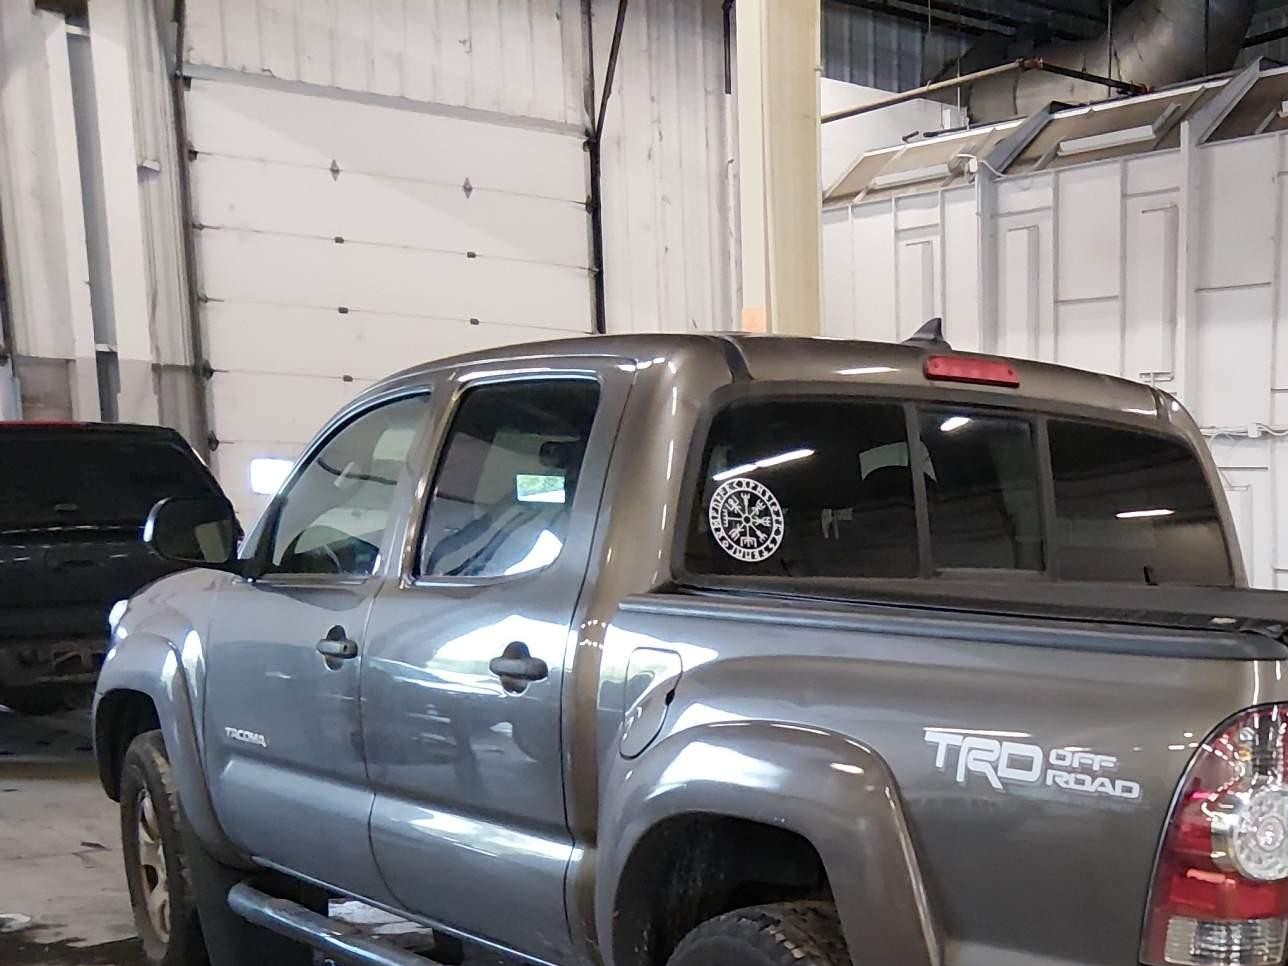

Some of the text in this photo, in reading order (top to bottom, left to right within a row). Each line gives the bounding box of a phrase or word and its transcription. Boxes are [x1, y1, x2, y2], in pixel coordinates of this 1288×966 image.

[225, 727, 267, 747] TACOMA
[924, 730, 1043, 790] TRD
[1049, 748, 1117, 770] OFF
[1046, 768, 1140, 799] ROAD
